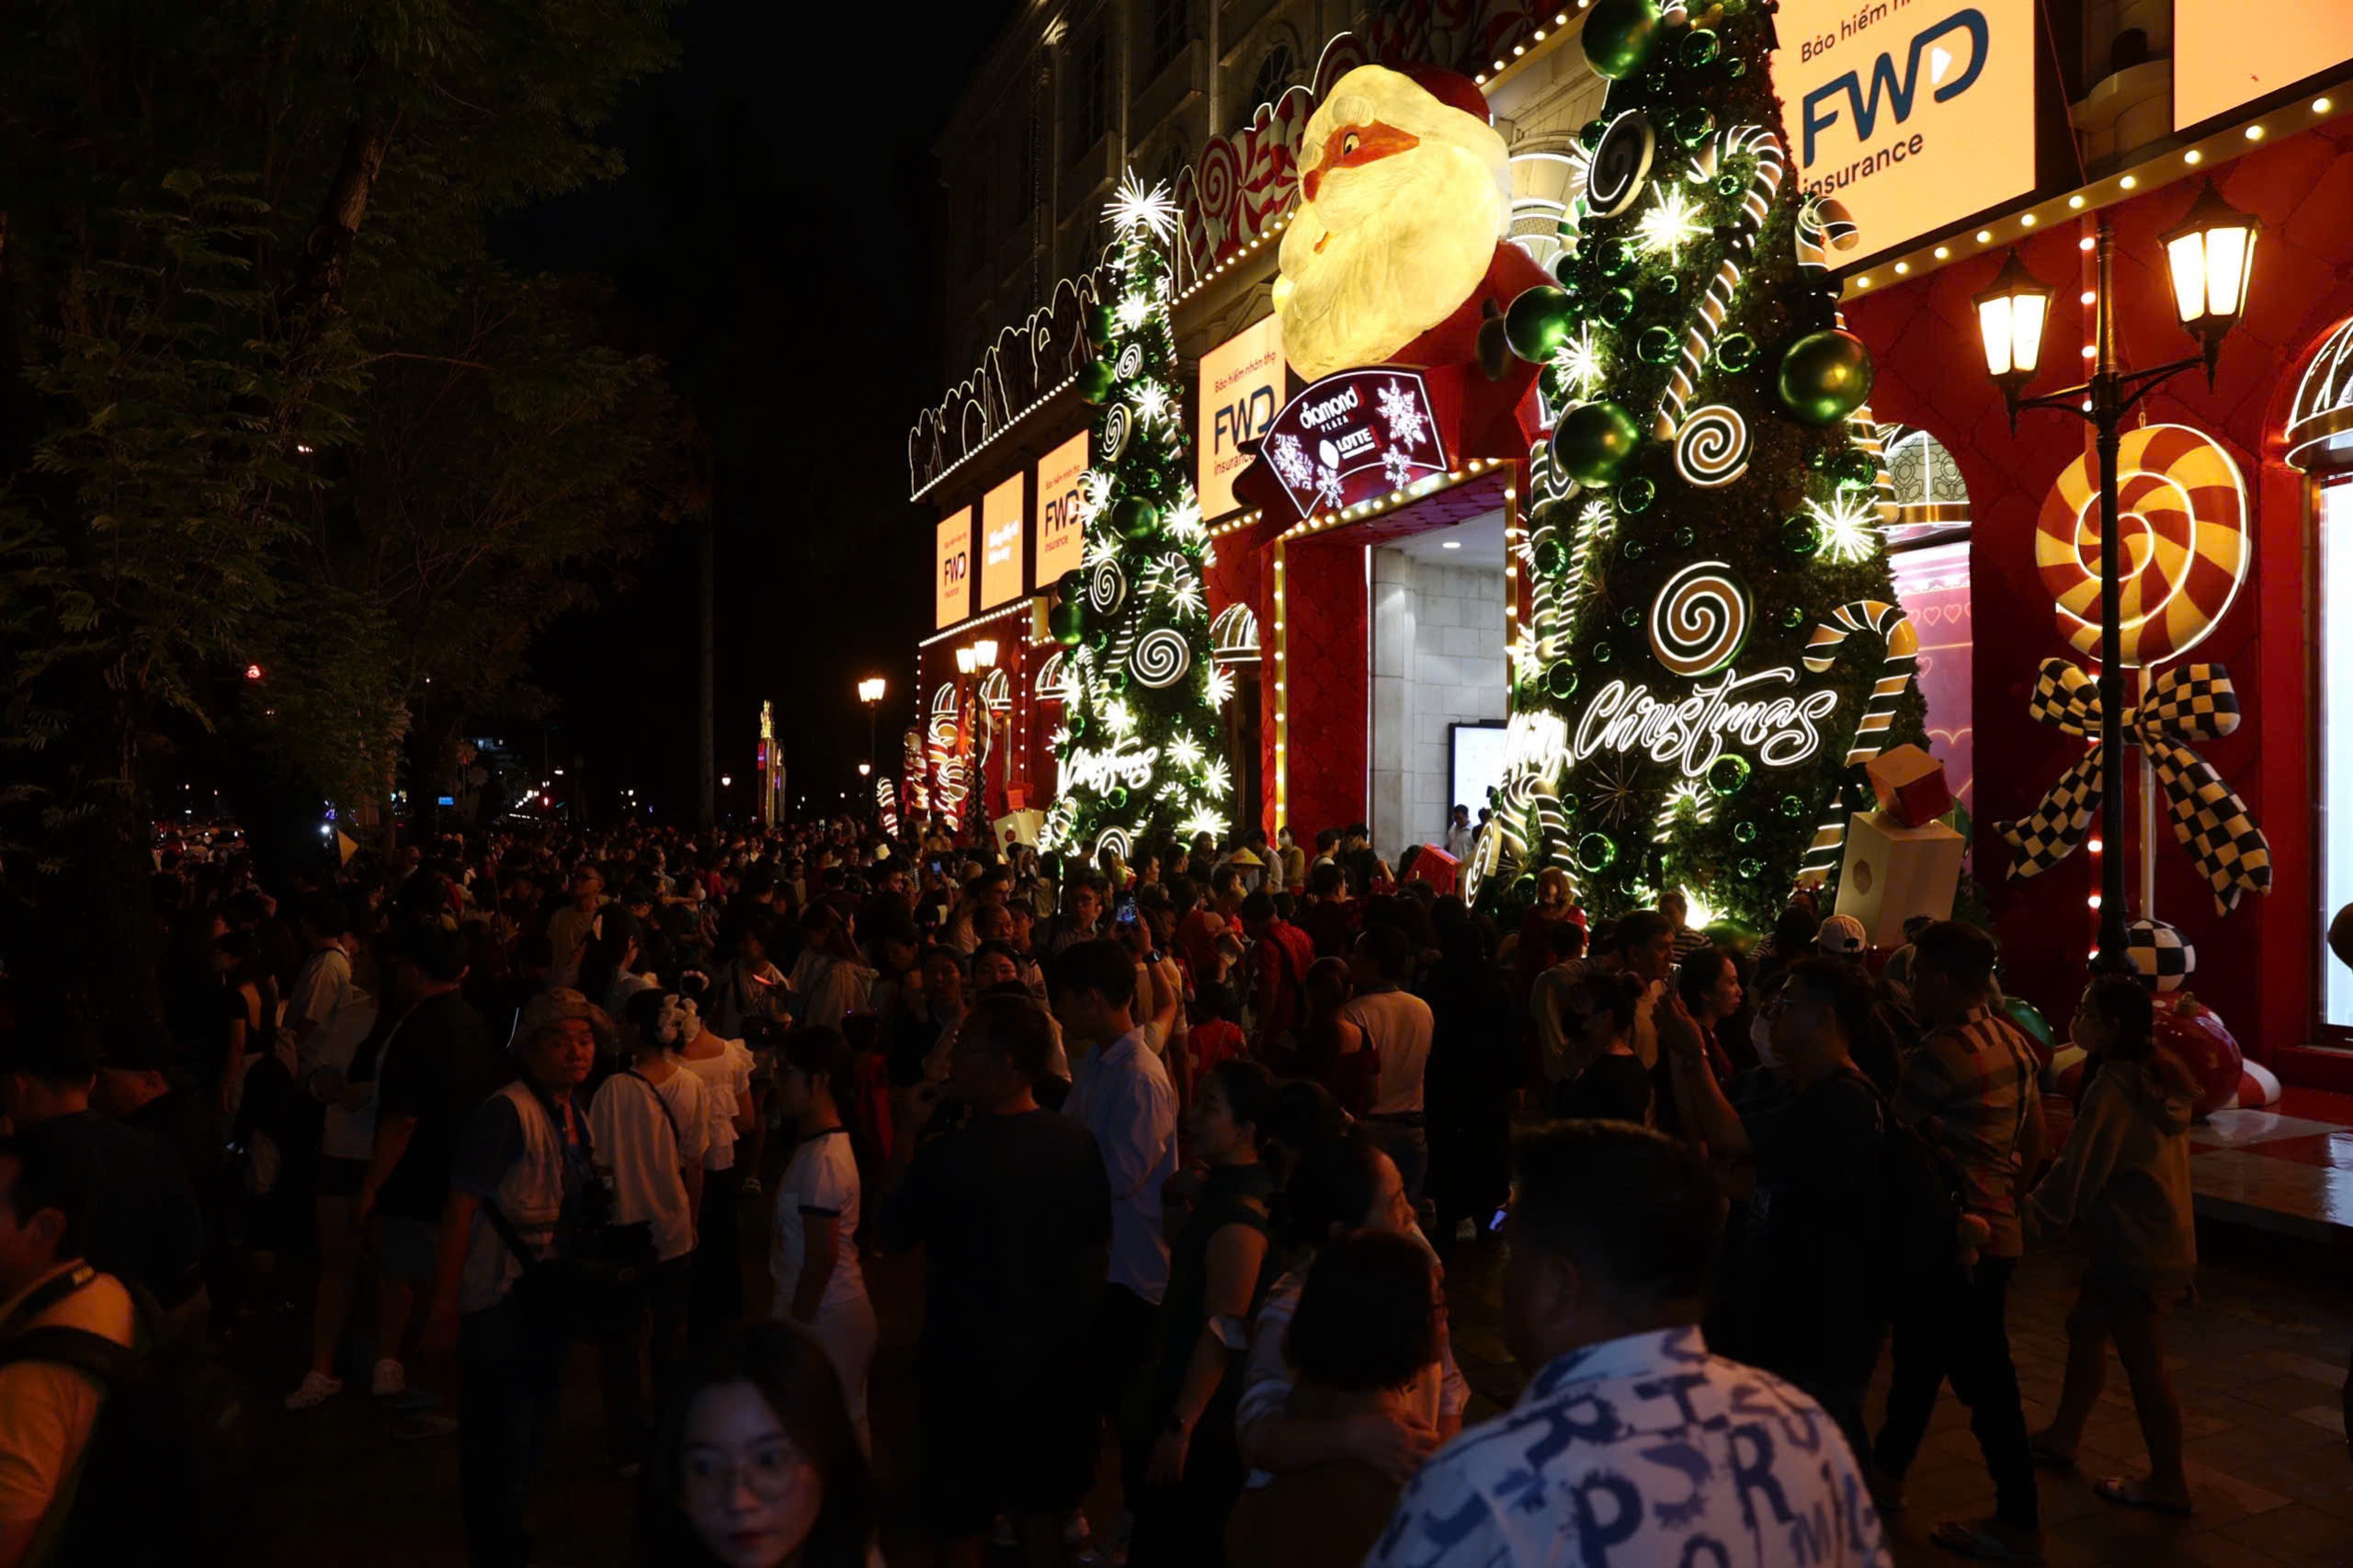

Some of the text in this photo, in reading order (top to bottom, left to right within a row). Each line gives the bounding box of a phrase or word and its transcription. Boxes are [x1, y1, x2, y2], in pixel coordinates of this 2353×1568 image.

[1801, 3, 1887, 63] Bảo hiểm
[1802, 8, 1989, 169] FWD
[1215, 384, 1275, 455] FWD
[1300, 385, 1358, 429] diamond
[1320, 415, 1349, 433] PLAZA
[1336, 427, 1373, 452] LOTTE
[1045, 489, 1080, 538] FWD
[944, 551, 966, 587] FWD
[1574, 667, 1837, 778] Christmas
